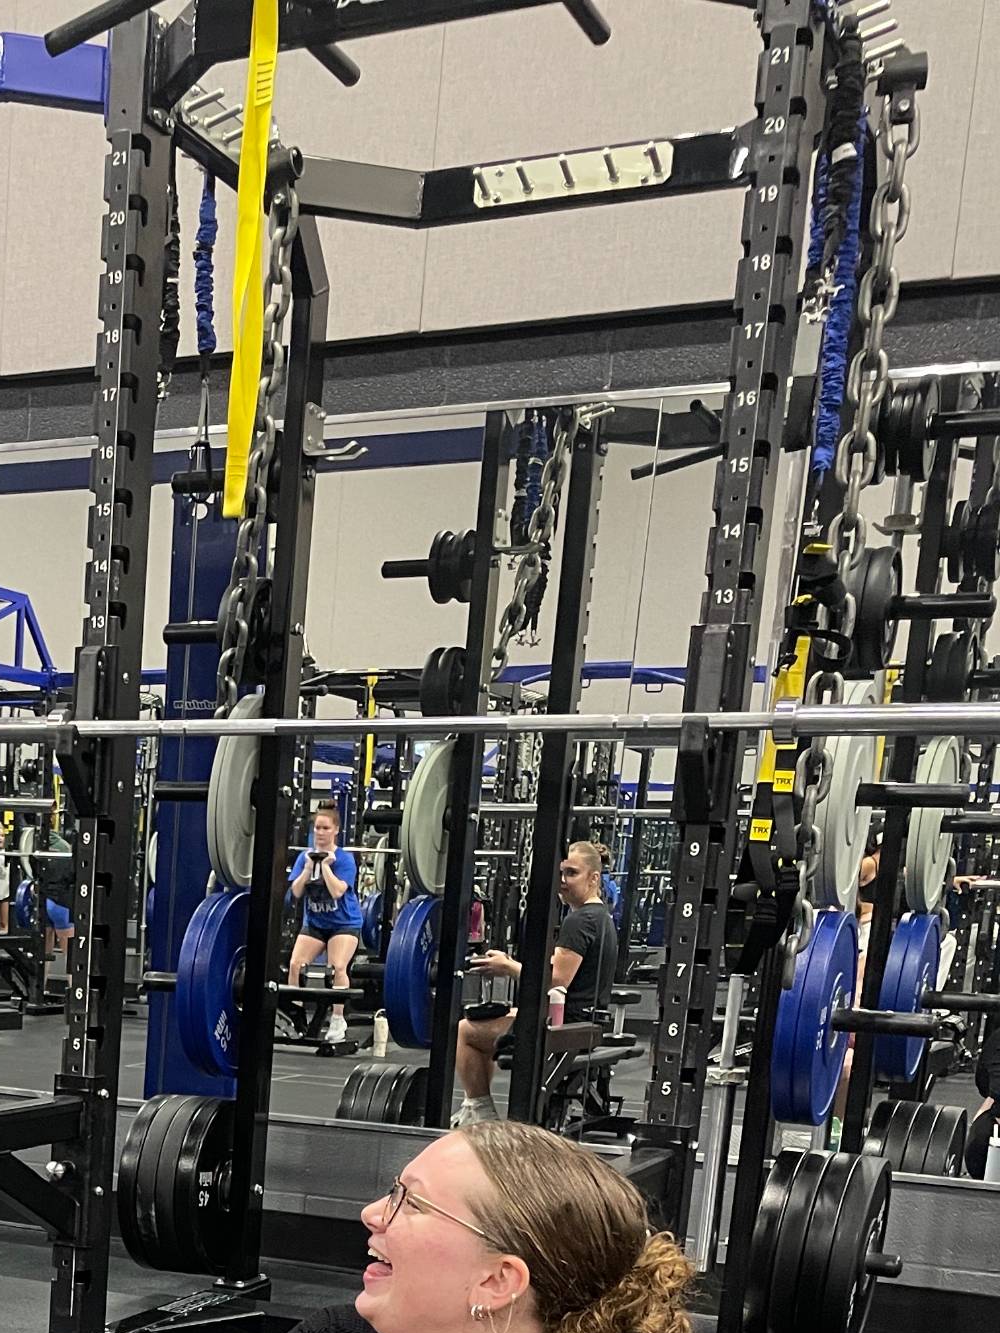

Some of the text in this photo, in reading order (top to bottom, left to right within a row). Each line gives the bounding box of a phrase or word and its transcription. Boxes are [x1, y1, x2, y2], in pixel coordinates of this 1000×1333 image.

[770, 46, 790, 64] 21
[763, 116, 786, 134] 20
[112, 151, 127, 166] 21
[758, 185, 779, 202] 19
[109, 211, 125, 226] 20
[751, 253, 771, 271] 18
[108, 270, 122, 285] 19
[105, 329, 119, 344] 18
[744, 322, 765, 339] 17
[102, 387, 117, 402] 17
[737, 390, 757, 407] 16
[99, 445, 114, 460] 16
[730, 457, 749, 473] 15
[96, 502, 111, 517] 15
[722, 523, 741, 539] 14
[93, 560, 108, 573] 14
[714, 588, 734, 604] 13
[91, 615, 105, 629] 13
[776, 777, 792, 785] TRX
[753, 826, 769, 834] TRX
[83, 831, 91, 845] 9
[689, 841, 700, 857] 9
[80, 884, 88, 897] 8
[682, 902, 693, 918] 8
[78, 936, 86, 949] 7
[676, 963, 686, 978] 7
[75, 987, 83, 1000] 6
[668, 1022, 678, 1037] 6
[73, 1037, 81, 1051] 5
[661, 1081, 671, 1096] 5
[199, 1190, 210, 1207] 45
